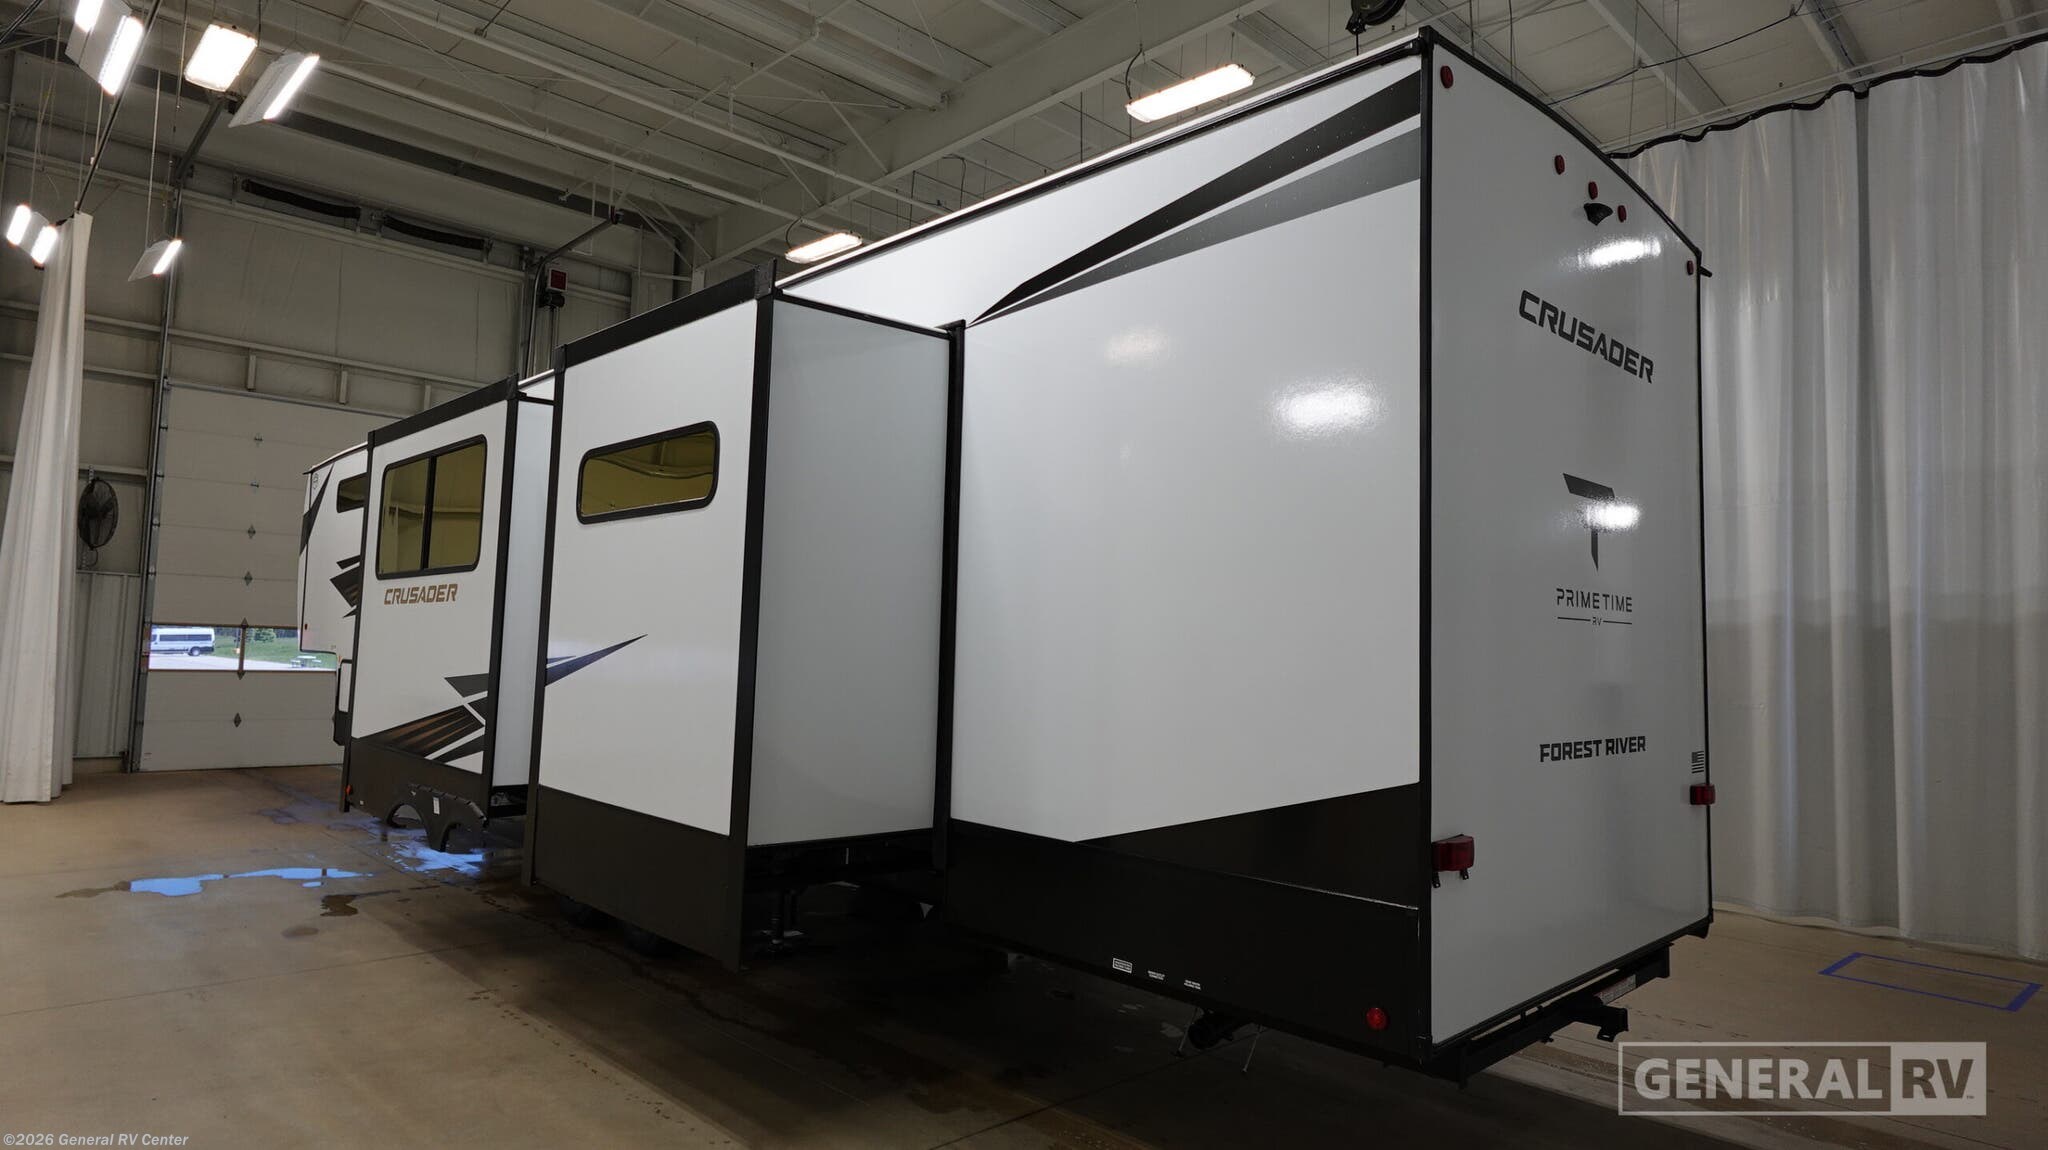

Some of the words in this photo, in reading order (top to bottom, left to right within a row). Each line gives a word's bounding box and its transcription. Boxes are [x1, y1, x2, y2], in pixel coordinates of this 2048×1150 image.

[1519, 290, 1654, 384] CRUSADER
[383, 583, 458, 605] CRUSADER
[1591, 616, 1602, 626] RV
[1539, 739, 1602, 762] FOREST
[1605, 735, 1646, 755] RIVER
